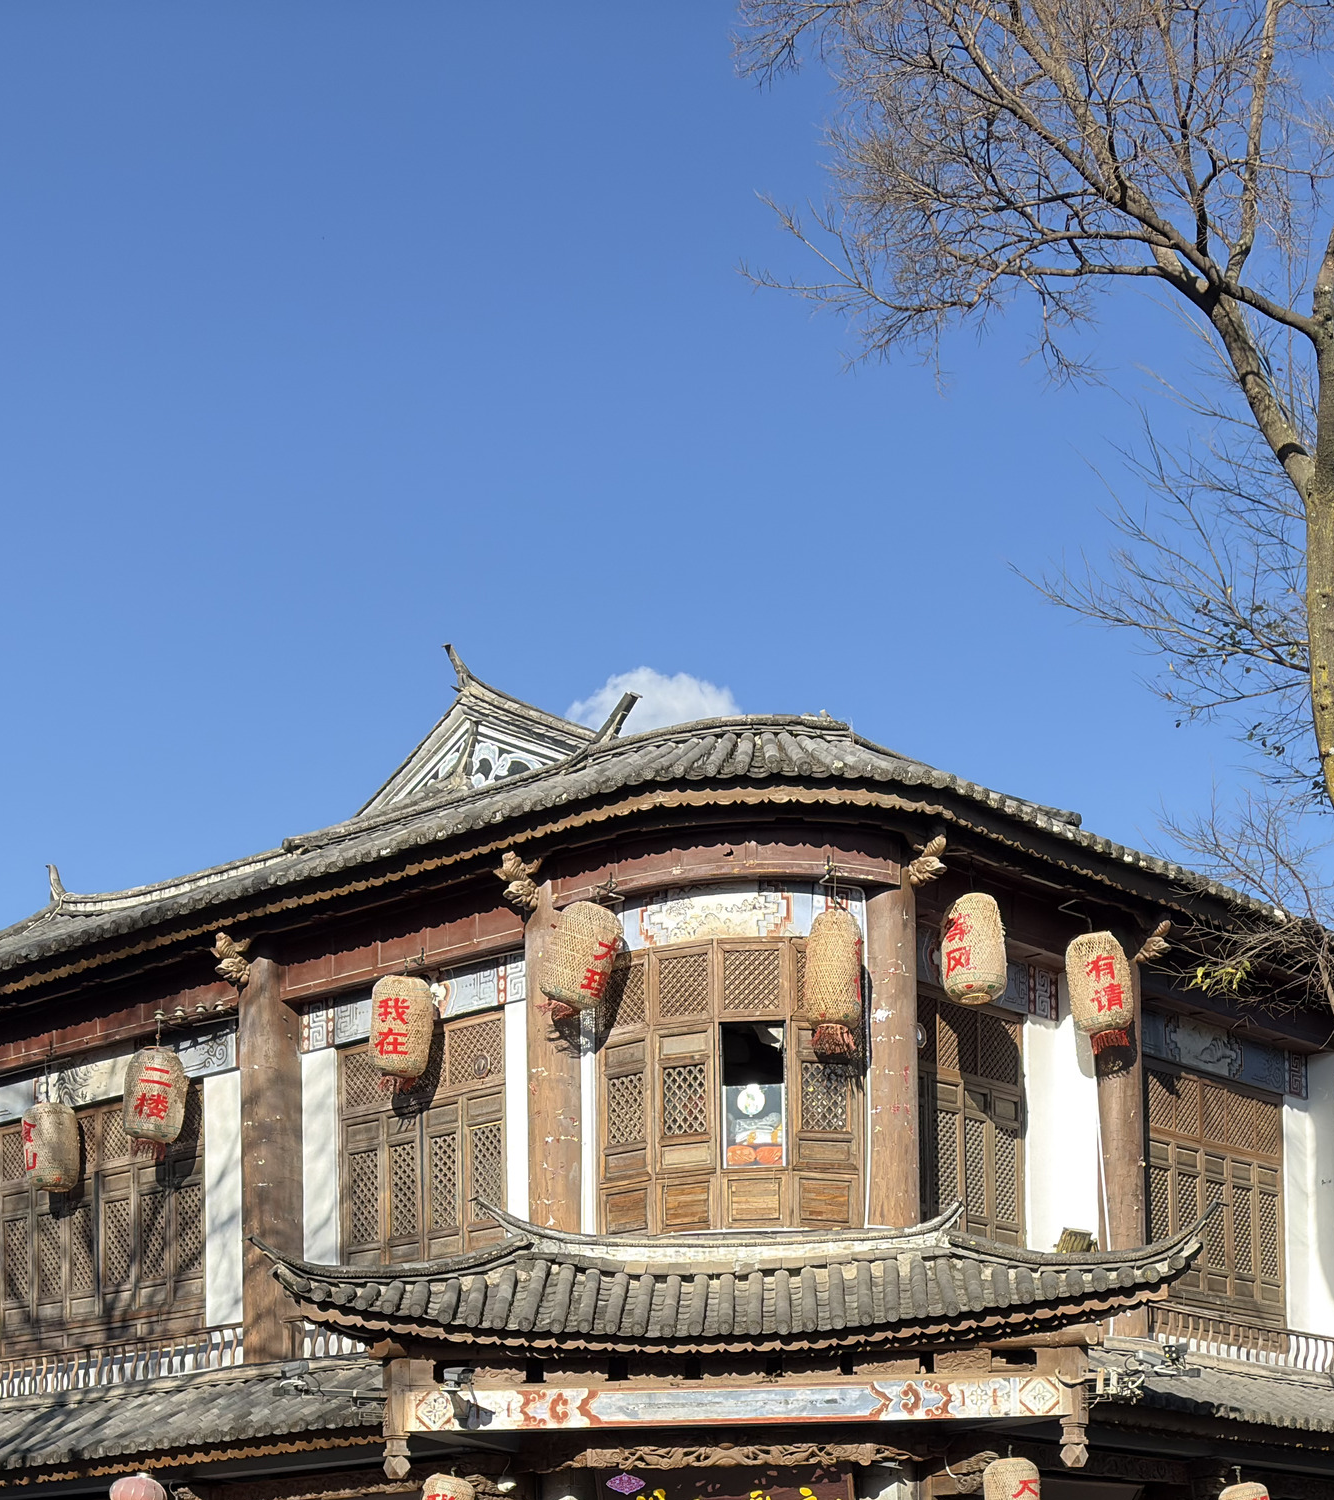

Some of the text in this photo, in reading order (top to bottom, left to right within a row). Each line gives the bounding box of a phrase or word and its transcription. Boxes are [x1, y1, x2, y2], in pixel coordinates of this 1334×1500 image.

[1085, 953, 1125, 1013] 有请
[374, 997, 410, 1056] 我在
[134, 1066, 172, 1120] 二楼
